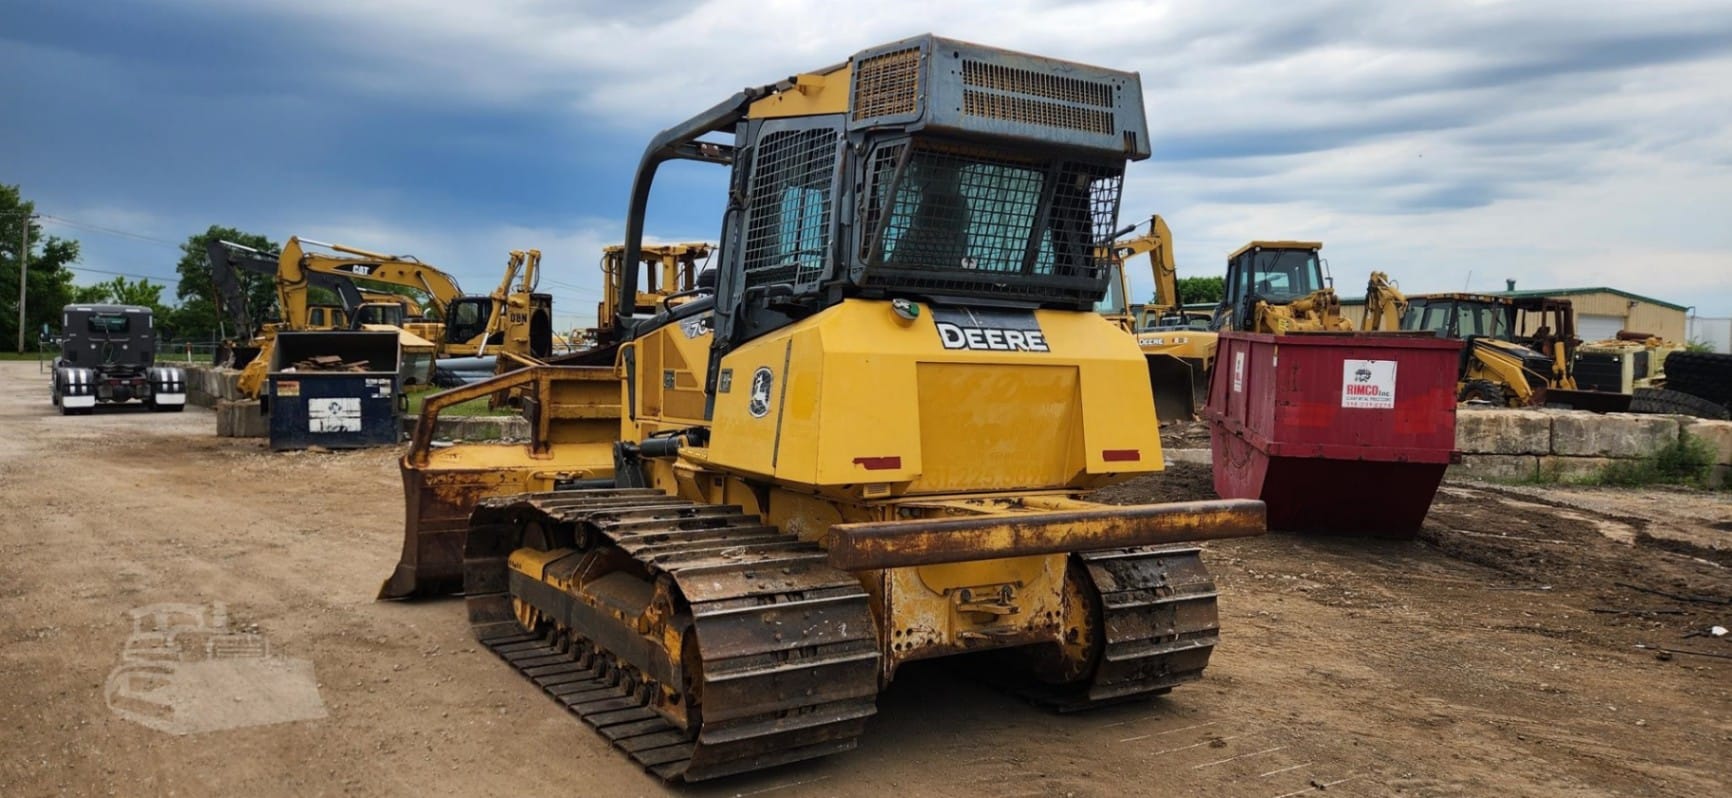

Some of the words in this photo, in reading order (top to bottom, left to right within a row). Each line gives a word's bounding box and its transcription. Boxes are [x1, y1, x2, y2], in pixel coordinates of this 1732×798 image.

[352, 264, 370, 276] CAT
[936, 322, 1049, 352] DEERE
[1139, 337, 1164, 346] DEERE
[1346, 384, 1379, 396] RIMCO
